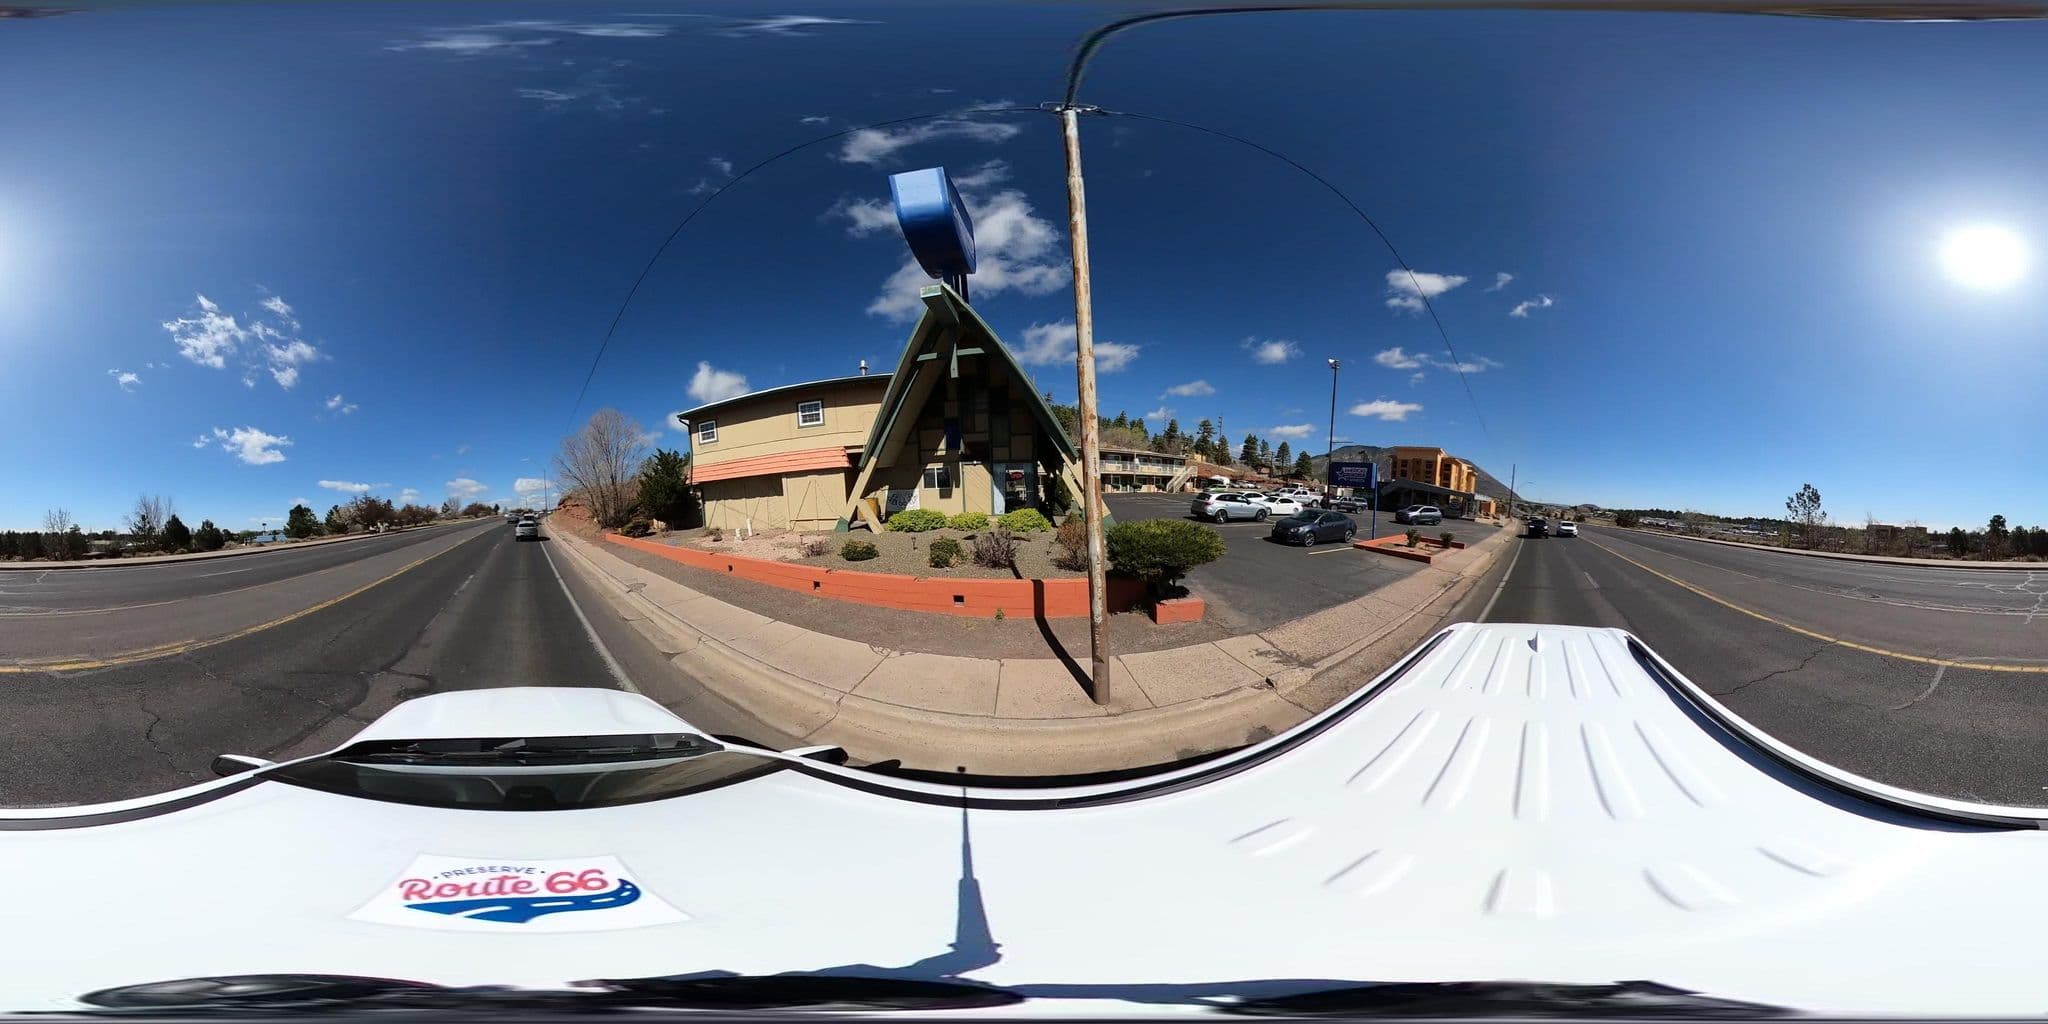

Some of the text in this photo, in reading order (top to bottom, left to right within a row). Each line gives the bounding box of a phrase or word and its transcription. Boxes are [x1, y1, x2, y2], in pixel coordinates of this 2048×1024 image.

[443, 866, 535, 879] PRESERVE
[398, 868, 609, 901] Route 66
